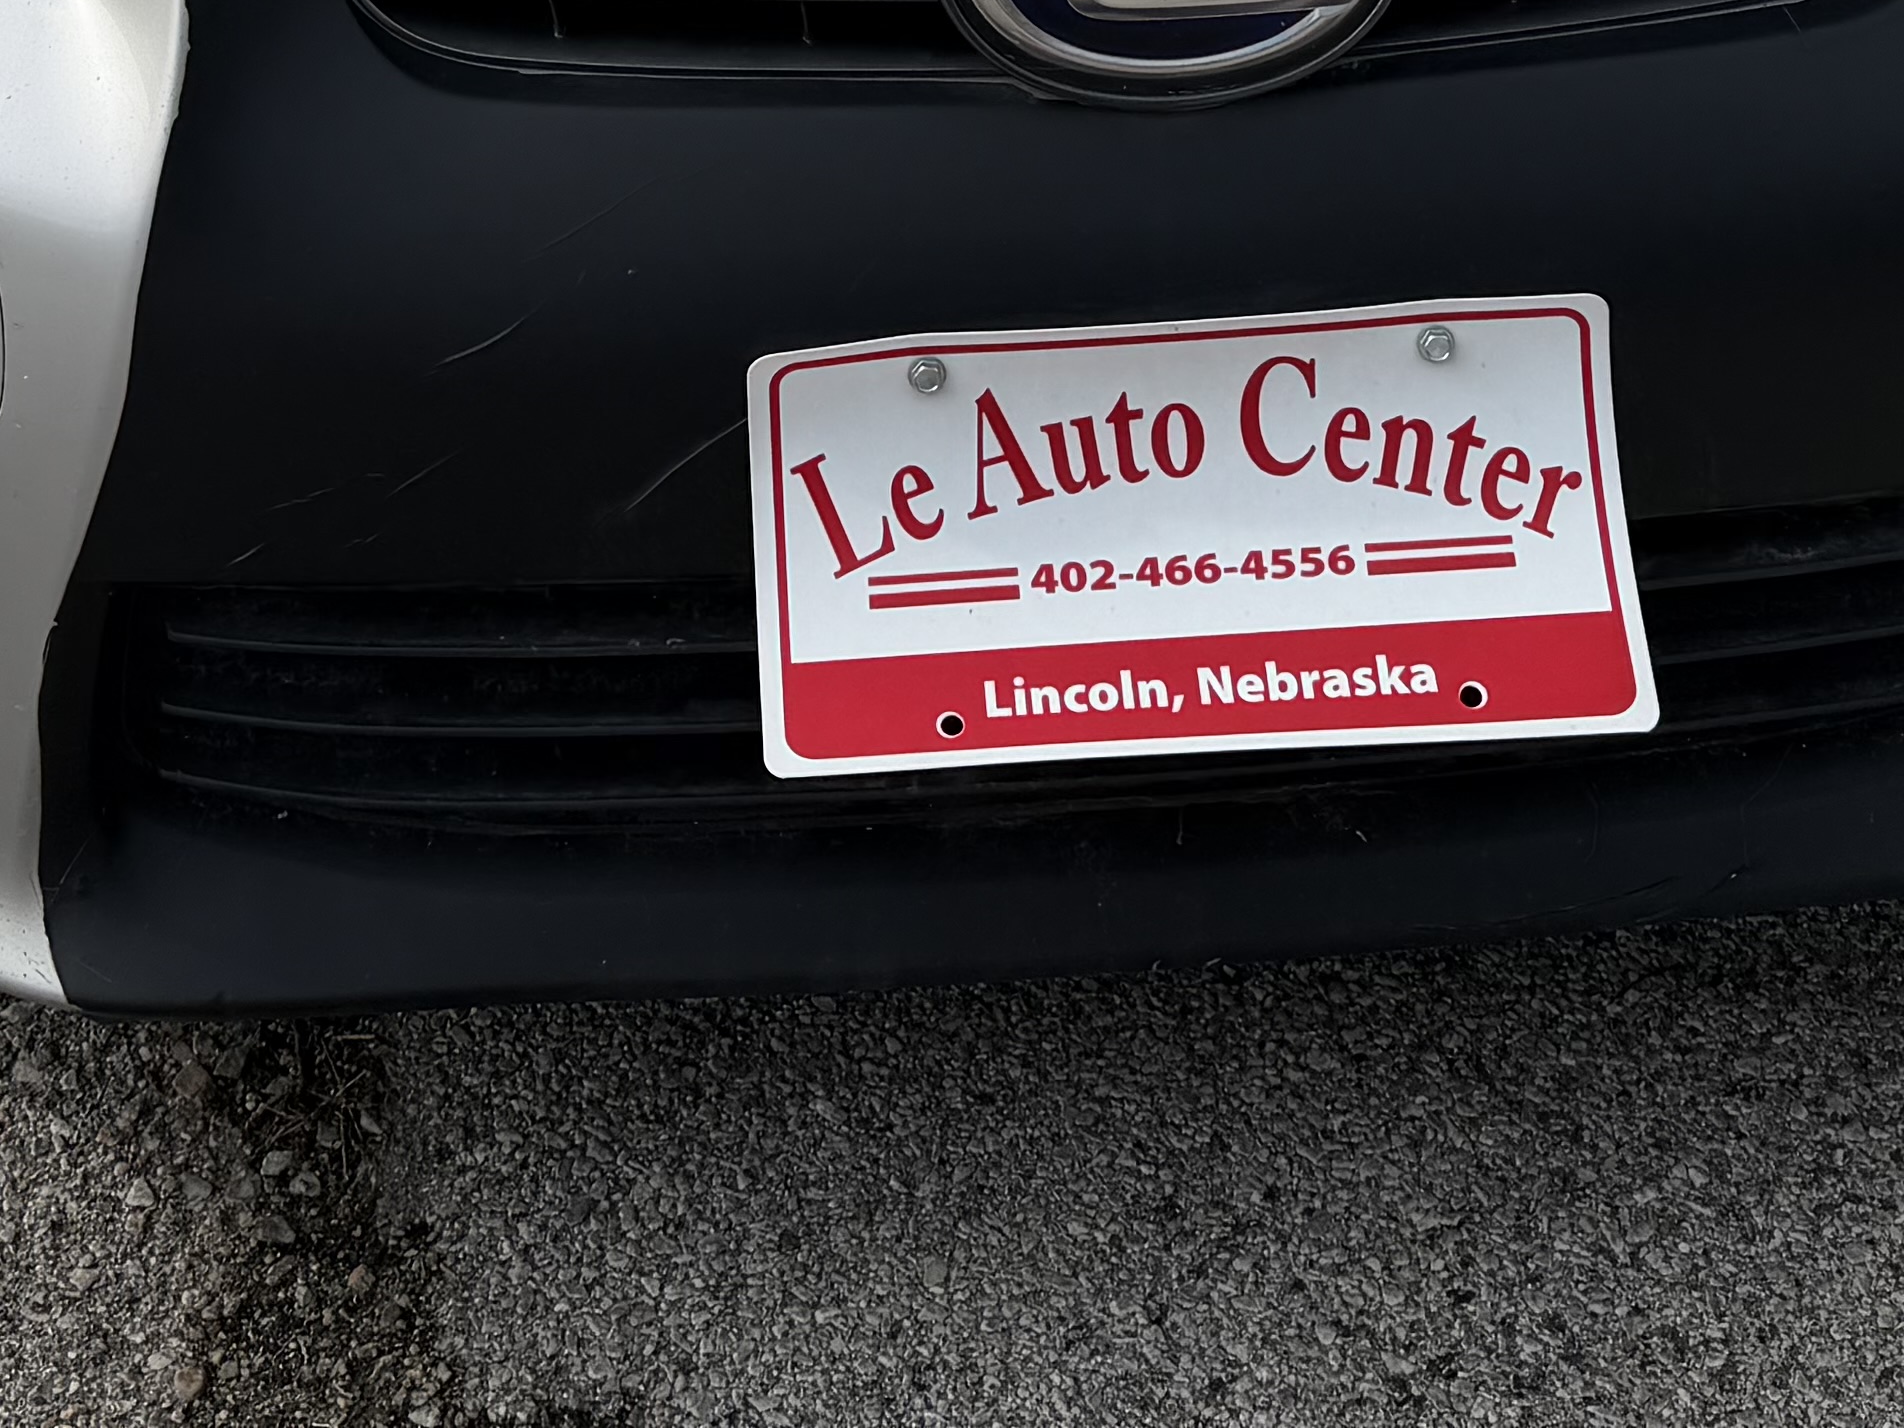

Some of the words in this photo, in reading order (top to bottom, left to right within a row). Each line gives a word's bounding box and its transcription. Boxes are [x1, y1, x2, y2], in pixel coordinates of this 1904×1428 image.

[790, 453, 945, 580] Le
[967, 387, 1206, 520] Auto
[1240, 355, 1583, 539] Center
[1031, 545, 1356, 594] 402-466-4556
[983, 669, 1185, 719] Lincoln,
[1196, 654, 1439, 706] Nebraska
